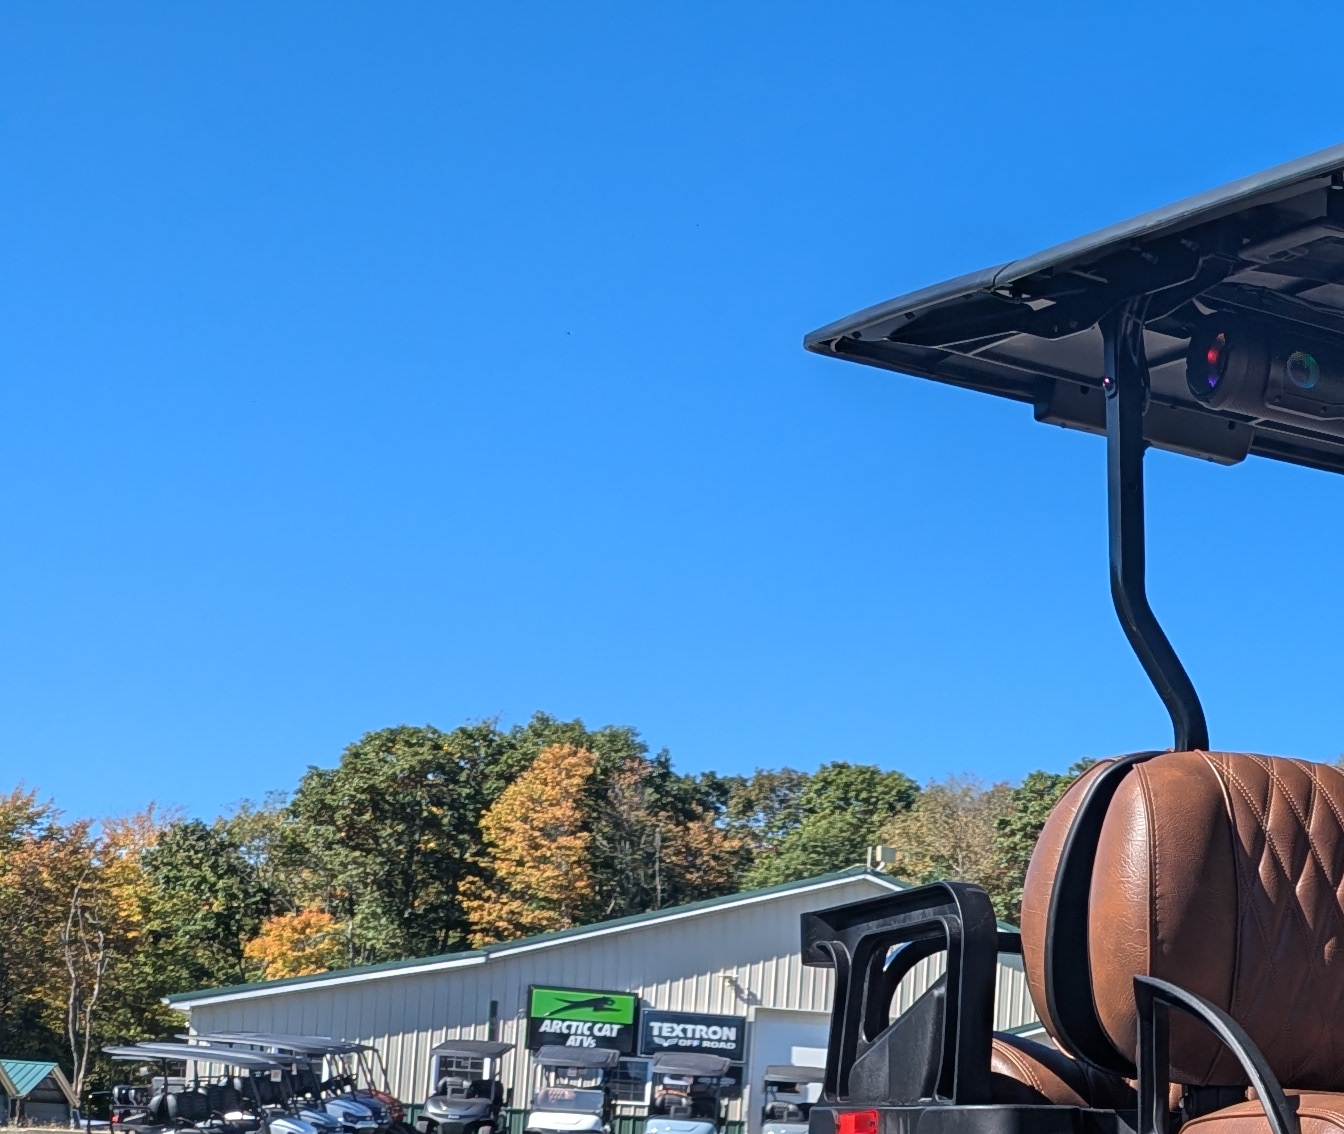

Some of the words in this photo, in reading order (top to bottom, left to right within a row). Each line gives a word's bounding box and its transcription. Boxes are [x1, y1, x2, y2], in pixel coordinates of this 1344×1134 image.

[539, 1019, 591, 1037] ARCTIC
[592, 1022, 624, 1038] CAT
[649, 1021, 737, 1042] TEXTRON
[565, 1035, 597, 1048] ATVs
[677, 1038, 700, 1048] OFF
[701, 1040, 737, 1050] ROAD
